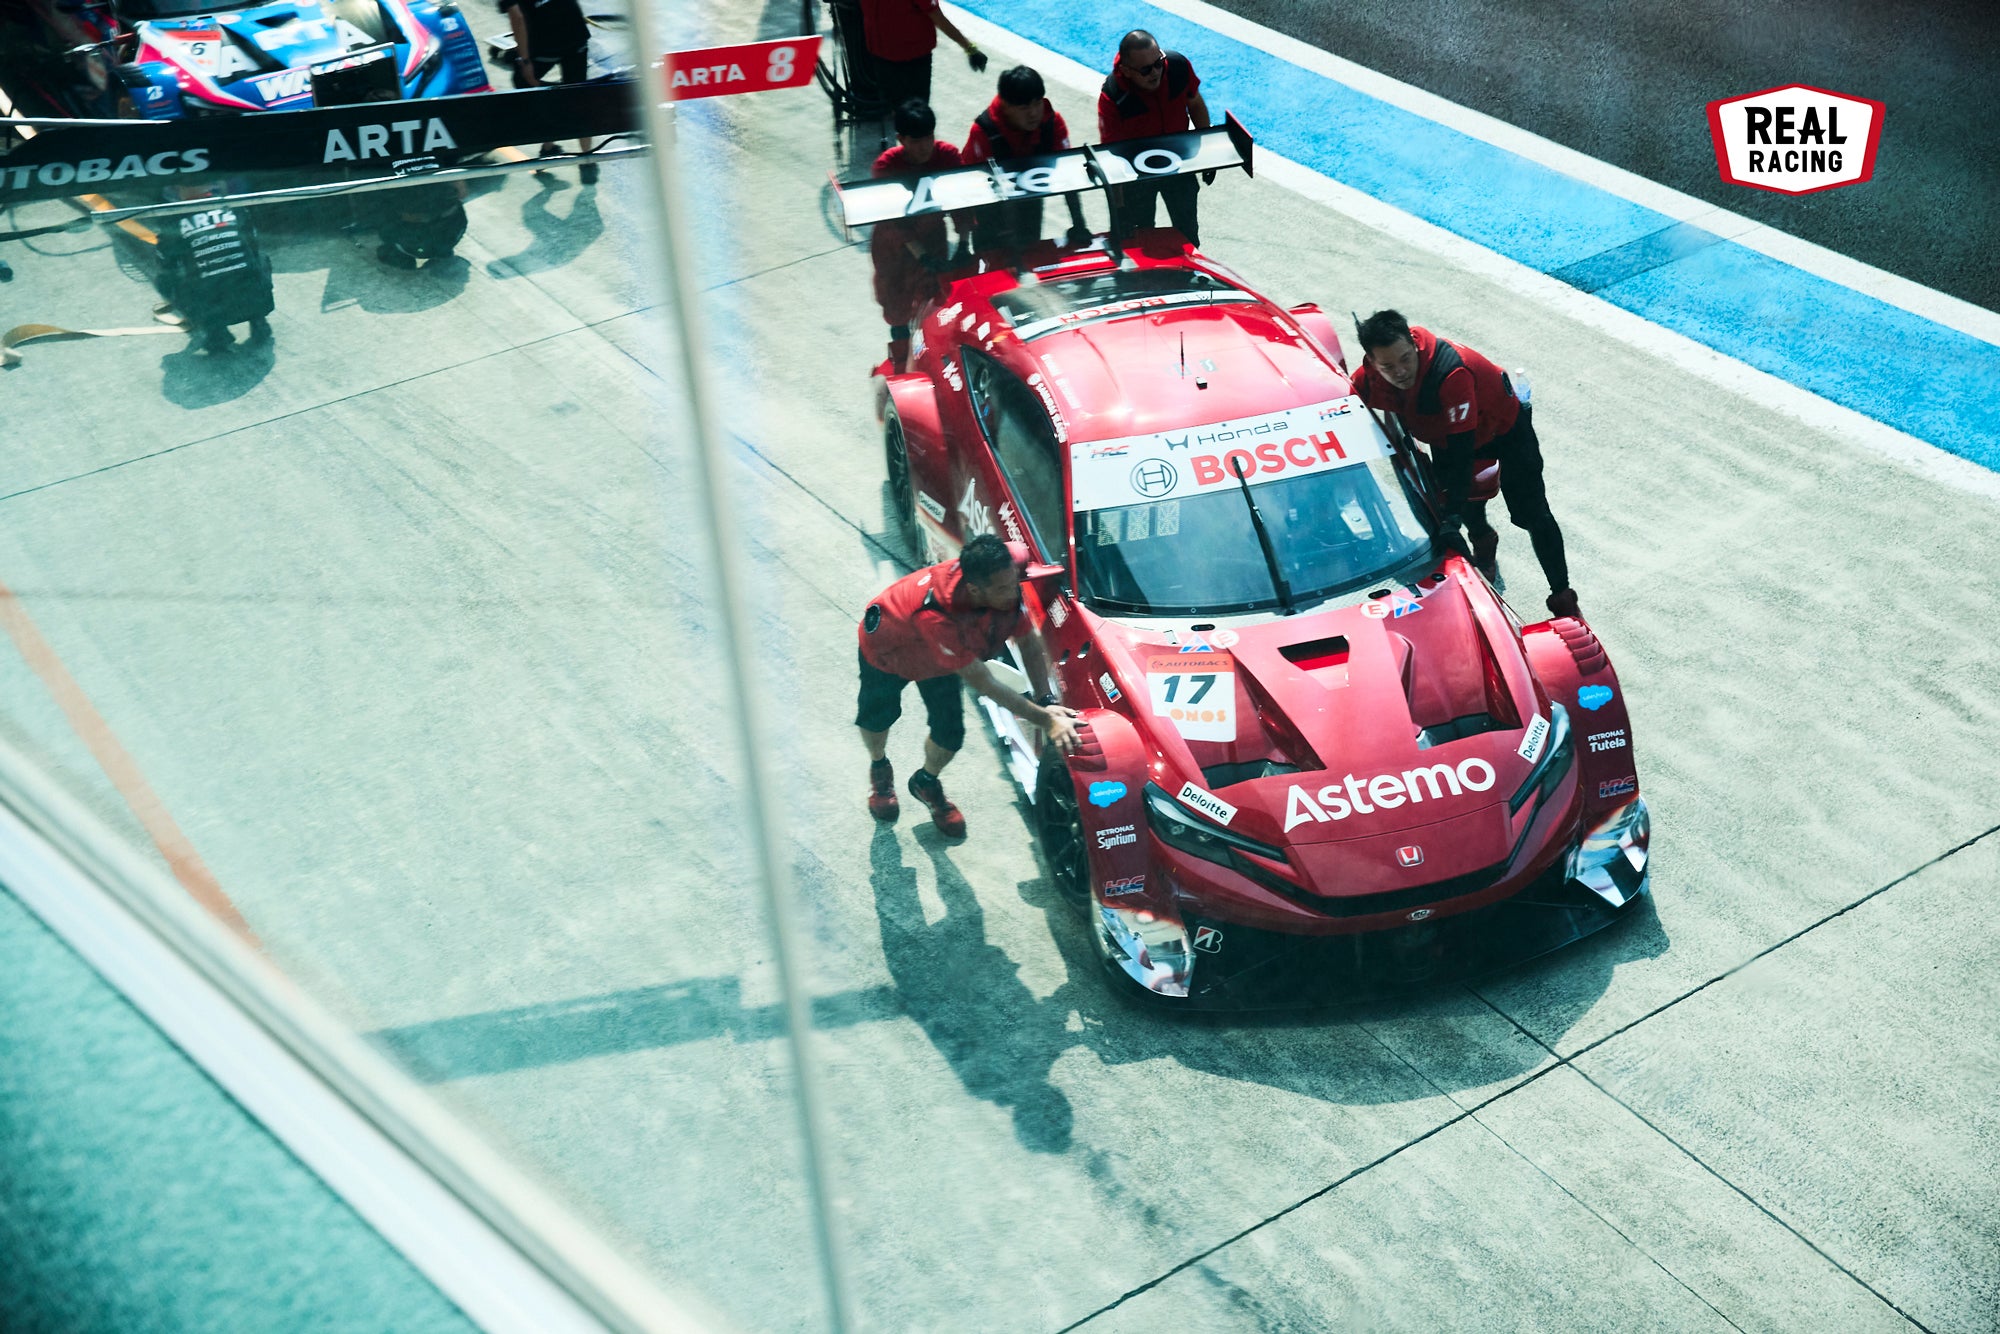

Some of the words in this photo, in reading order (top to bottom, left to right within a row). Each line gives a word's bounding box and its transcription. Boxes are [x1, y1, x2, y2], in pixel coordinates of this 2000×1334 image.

[671, 63, 746, 89] ARTA
[766, 46, 796, 82] 8
[0, 148, 210, 190] TOBACS
[323, 117, 458, 164] ARTA
[1448, 402, 1470, 423] 17
[1197, 421, 1288, 445] Honda
[1190, 430, 1347, 486] BOSCH
[1164, 660, 1229, 668] AUTOBACS
[1163, 674, 1217, 705] 17
[1587, 729, 1625, 742] PETRONAS
[1589, 737, 1627, 753] Tutela
[1284, 757, 1496, 834] Astemo
[1096, 824, 1135, 838] PETRONAS
[1098, 833, 1137, 850] Syntium
